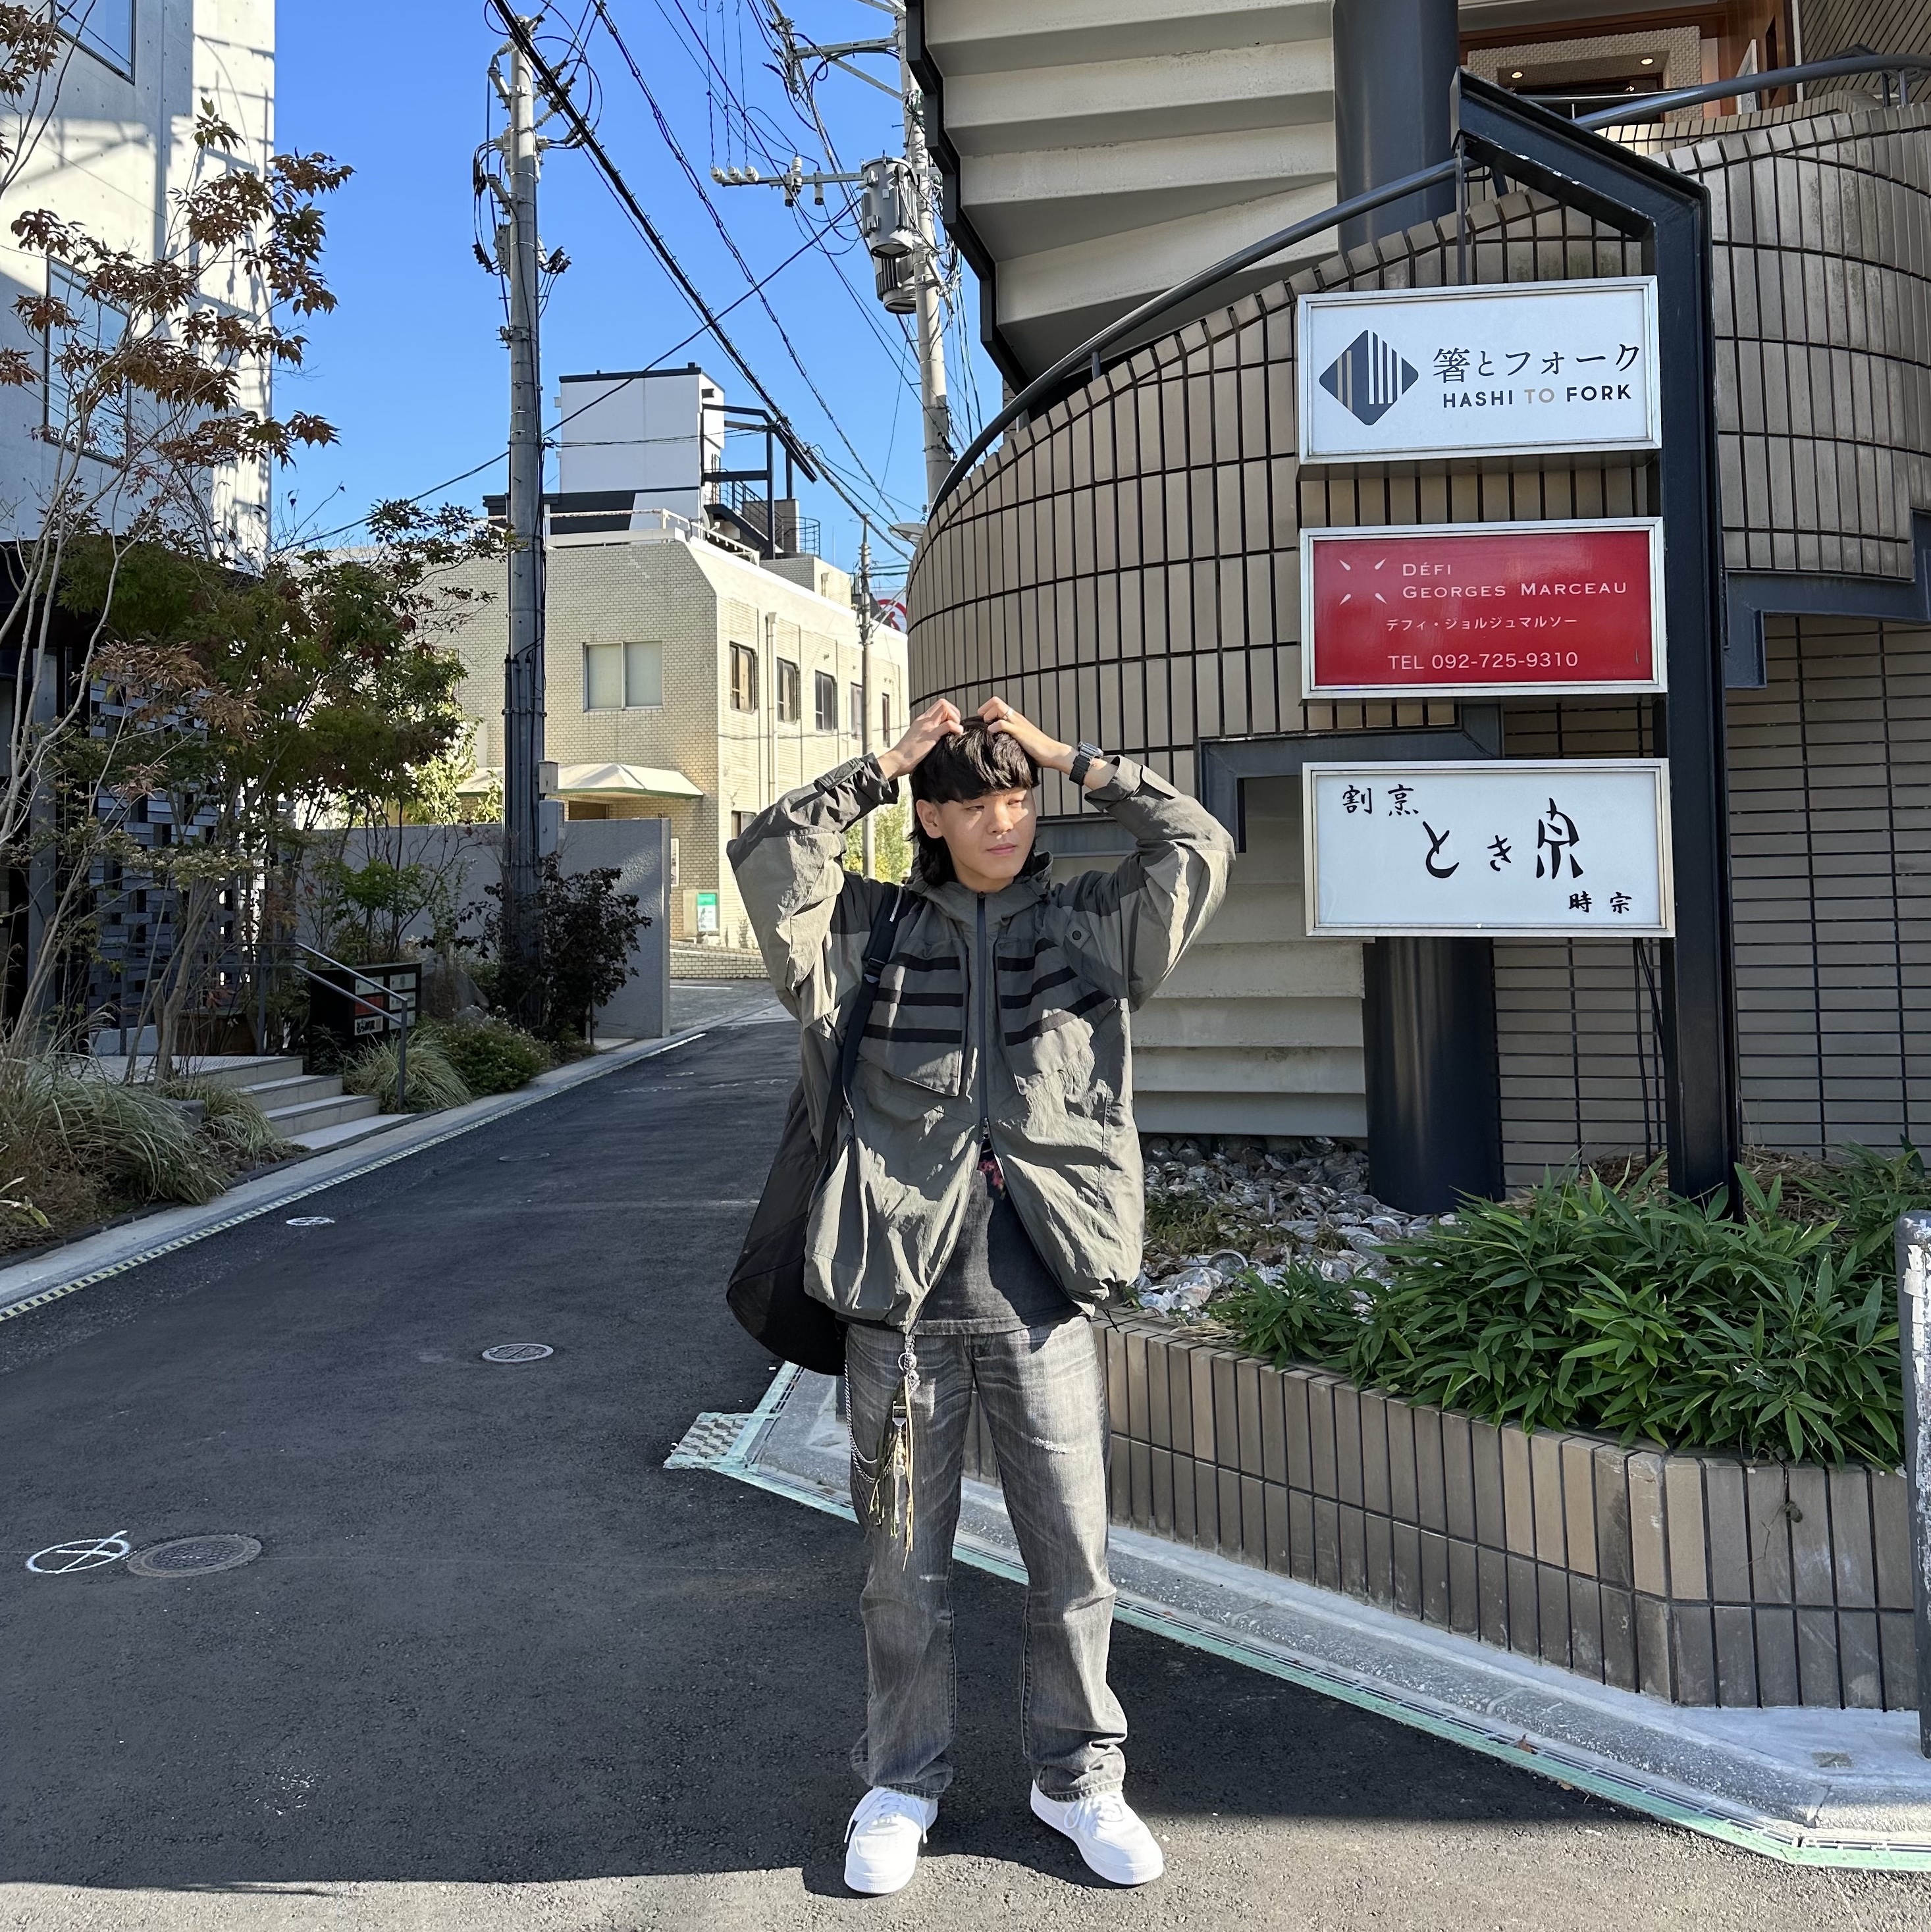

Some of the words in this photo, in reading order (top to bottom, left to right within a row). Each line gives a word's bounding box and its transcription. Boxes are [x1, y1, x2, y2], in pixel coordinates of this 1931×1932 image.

[1433, 344, 1640, 384] 箸とフォーク
[1443, 390, 1513, 408] HASHI
[1523, 388, 1555, 404] TO
[1566, 384, 1632, 402] FORK
[1402, 561, 1451, 577] DÉFI
[1402, 585, 1506, 600] GEORGES
[1520, 582, 1627, 596] MARCEAU
[1386, 615, 1577, 632] デフィ・ジョルジュマルソー
[1387, 655, 1424, 669] TEL
[1431, 652, 1578, 669] 092-725-9310
[1342, 783, 1419, 817] 割烹
[1568, 890, 1633, 914] 時宗
